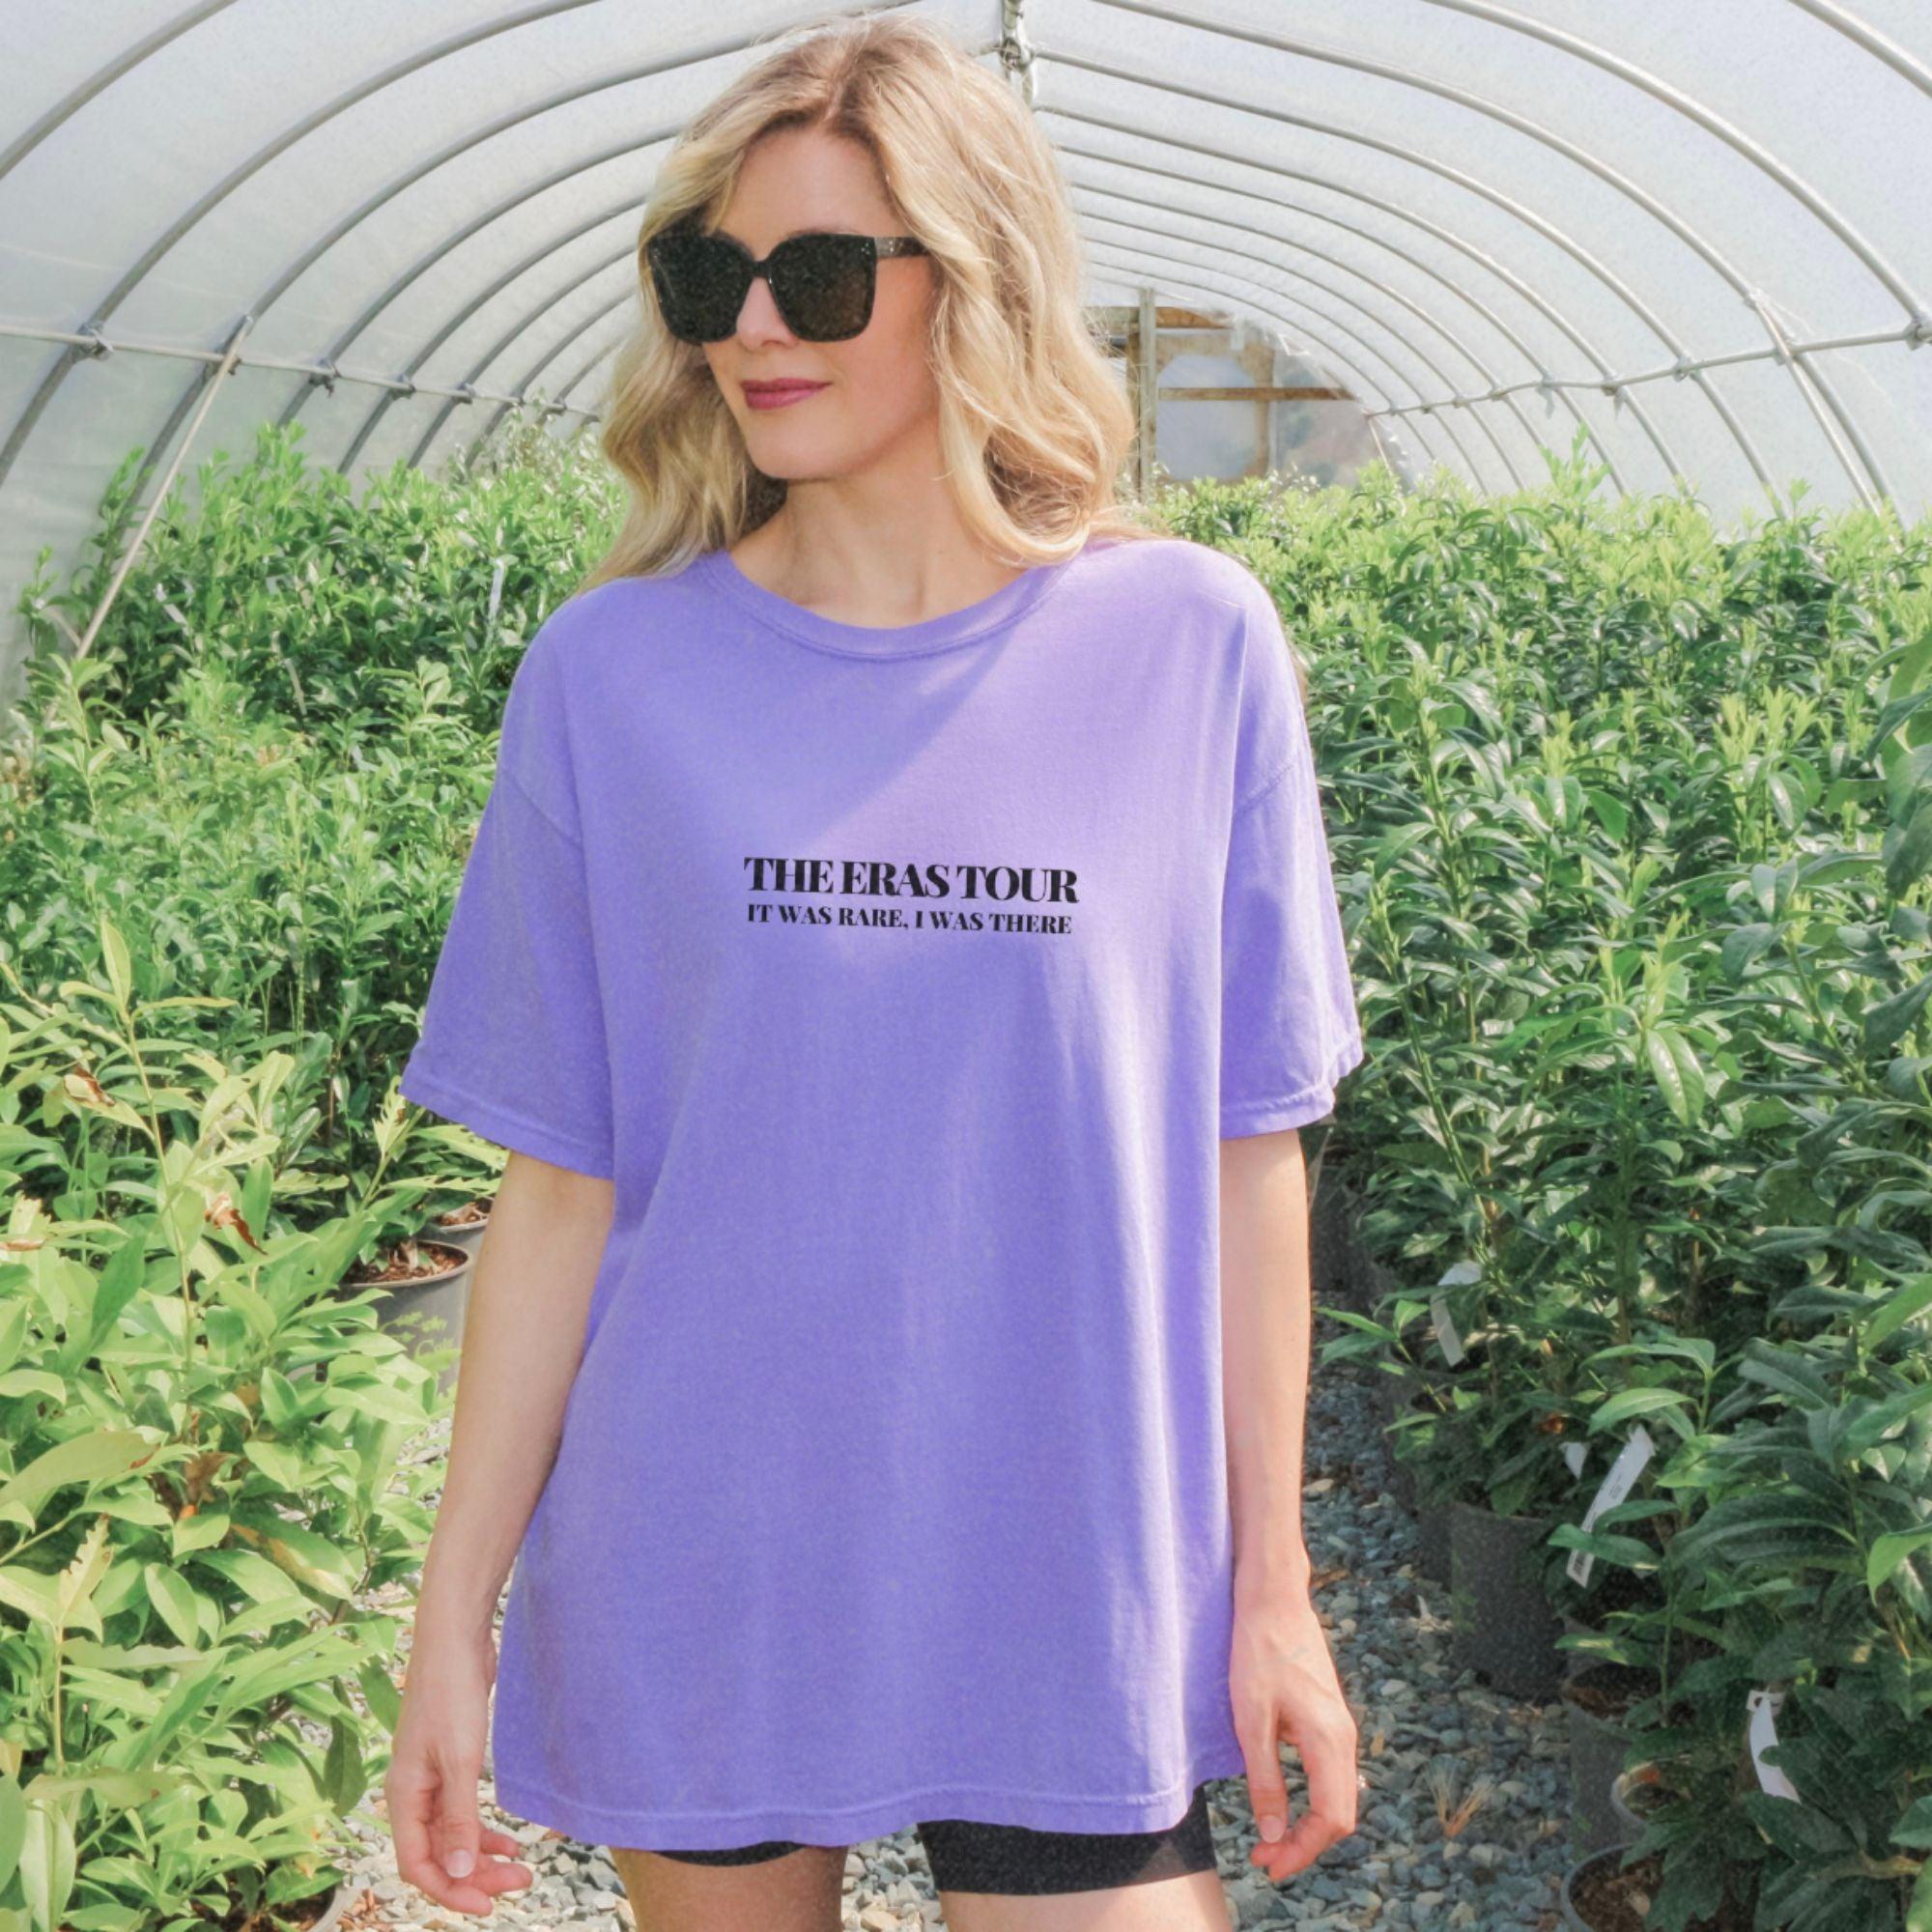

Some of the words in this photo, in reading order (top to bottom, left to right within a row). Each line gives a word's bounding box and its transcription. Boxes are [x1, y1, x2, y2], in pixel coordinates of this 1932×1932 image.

[744, 858, 834, 894] THE
[840, 861, 950, 898] ERAS
[956, 866, 1080, 903] TOUR
[748, 904, 773, 923] IT
[778, 905, 832, 924] WAS
[838, 908, 909, 930] RARE,
[915, 910, 924, 929] I
[928, 911, 983, 931] WAS
[988, 913, 1072, 934] THERE
